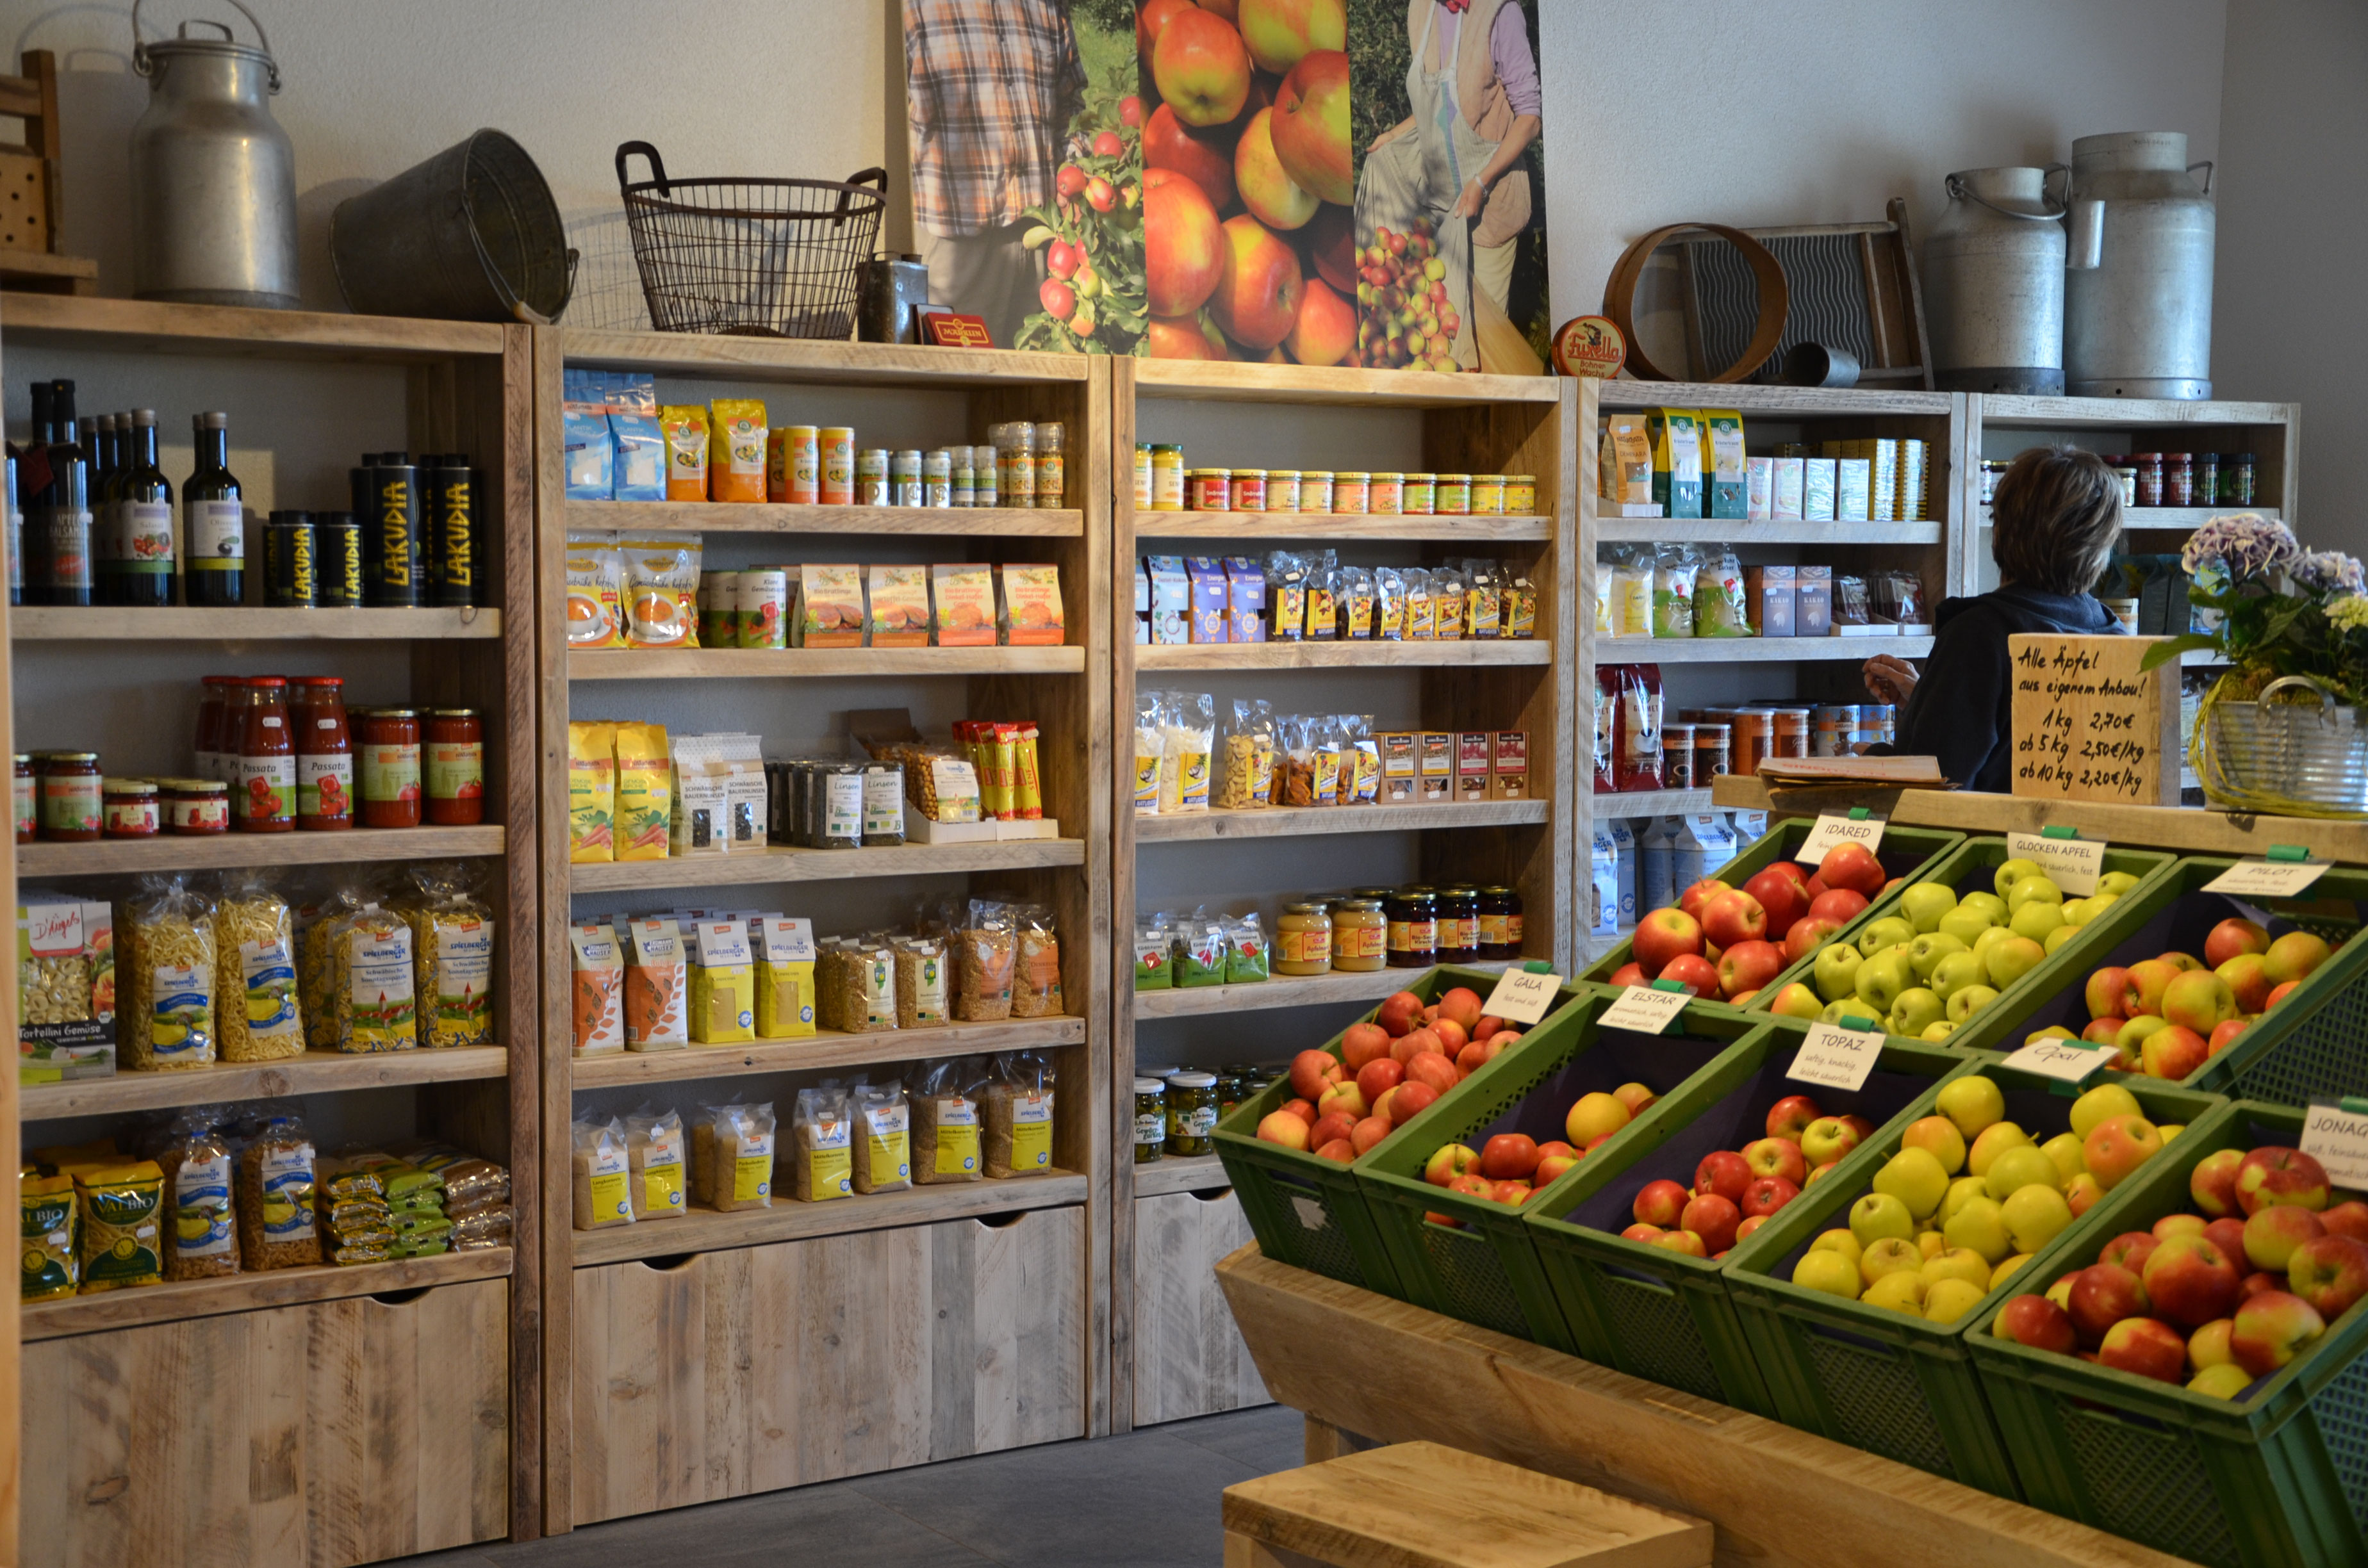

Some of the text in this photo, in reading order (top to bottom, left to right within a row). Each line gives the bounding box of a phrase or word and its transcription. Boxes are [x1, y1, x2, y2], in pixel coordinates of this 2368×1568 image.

[943, 327, 982, 338] MÄRKLIN
[1579, 368, 1606, 378] Wachs
[382, 481, 409, 586] LAKUDIA
[445, 482, 472, 587] LAKUDIA
[2018, 644, 2100, 678] Alle Äpfel
[2019, 677, 2147, 703] aus eigenem Anbau!
[2043, 708, 2135, 737] 1 kg 2,70€
[2019, 733, 2144, 764] ab 5 kg 2,50€/kg
[243, 762, 277, 774] Passata
[311, 761, 346, 772] Passata
[834, 781, 860, 790] Linsen
[867, 780, 898, 788] Linsen
[1026, 769, 1035, 790] SENF
[2019, 761, 2142, 797] ab 10 kg 2,20€/kg
[1825, 824, 1871, 838] IDARED
[2016, 840, 2092, 858] GLOCKEN APFEL
[2080, 866, 2093, 876] fest
[2248, 867, 2300, 876] PILOT
[707, 946, 745, 956] SPIELBERGER
[771, 943, 809, 952] SPIELBERGER
[1514, 977, 1543, 992] GALA
[1515, 997, 1527, 1006] und
[1631, 992, 1677, 1006] ELSTAR
[64, 1023, 101, 1035] Gemüse
[1821, 1033, 1865, 1051] TOPAZ
[2034, 1045, 2082, 1063] Opal
[1799, 1067, 1851, 1084] leicht säuerlich
